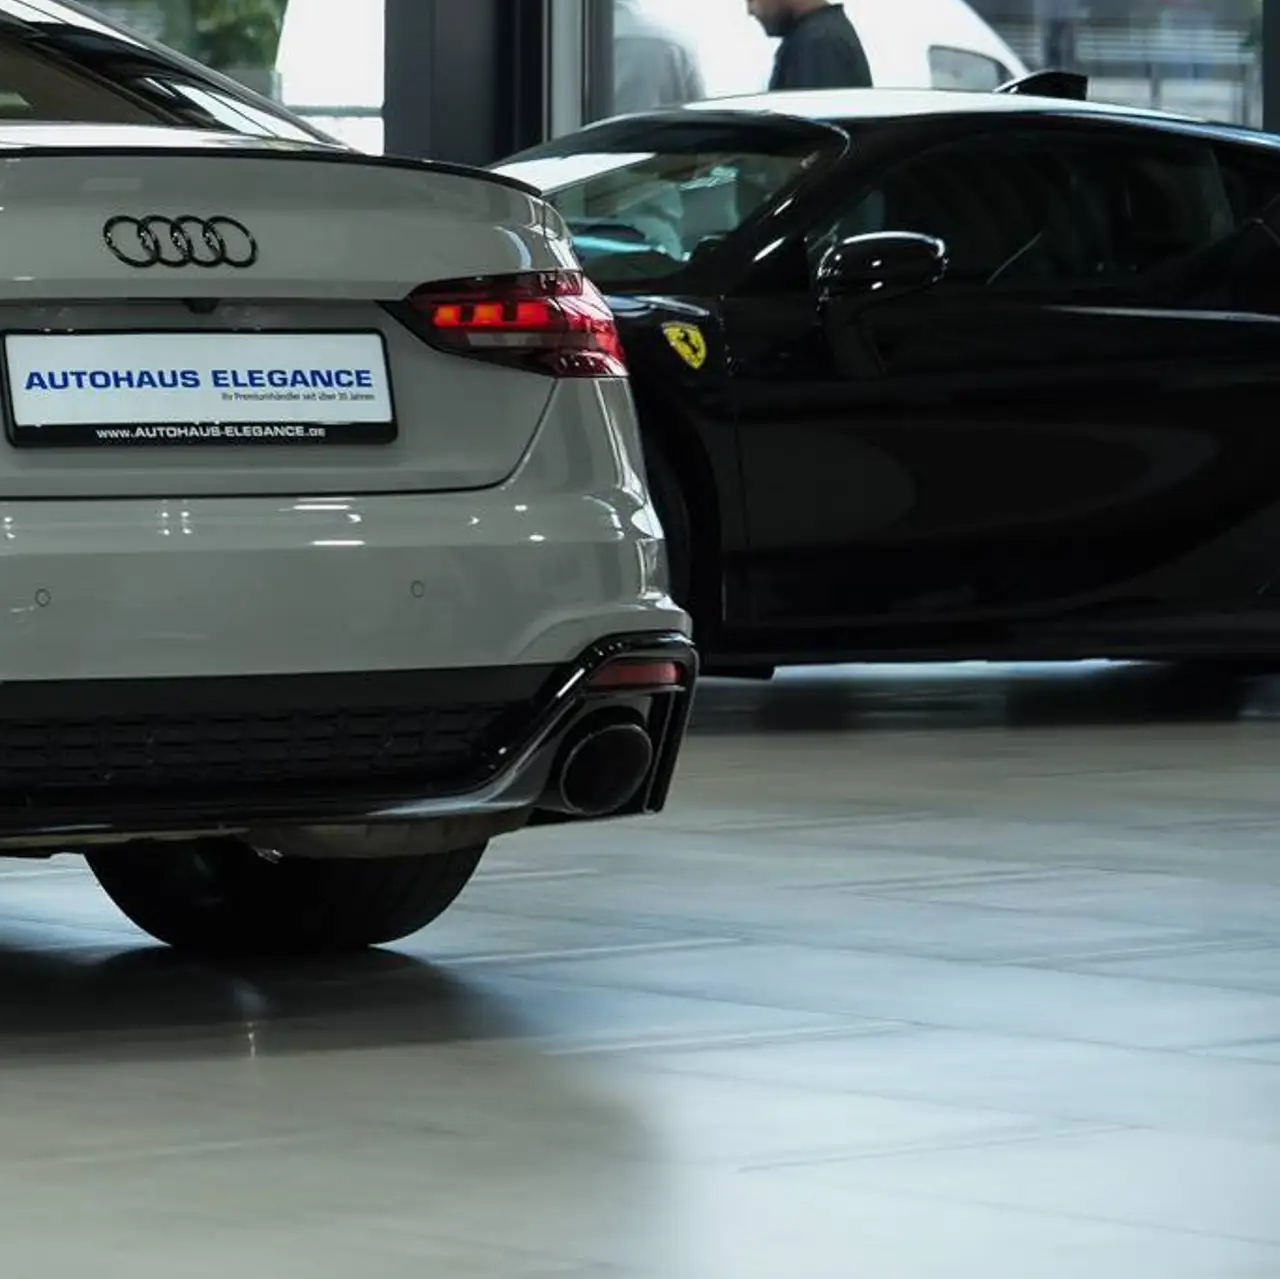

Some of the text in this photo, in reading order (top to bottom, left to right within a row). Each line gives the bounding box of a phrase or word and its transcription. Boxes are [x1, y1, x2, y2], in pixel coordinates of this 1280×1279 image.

[25, 369, 373, 390] AUTOHAUS ELEGANCE
[96, 425, 326, 439] www.AUTOHAUS-ELEGANCE.de
